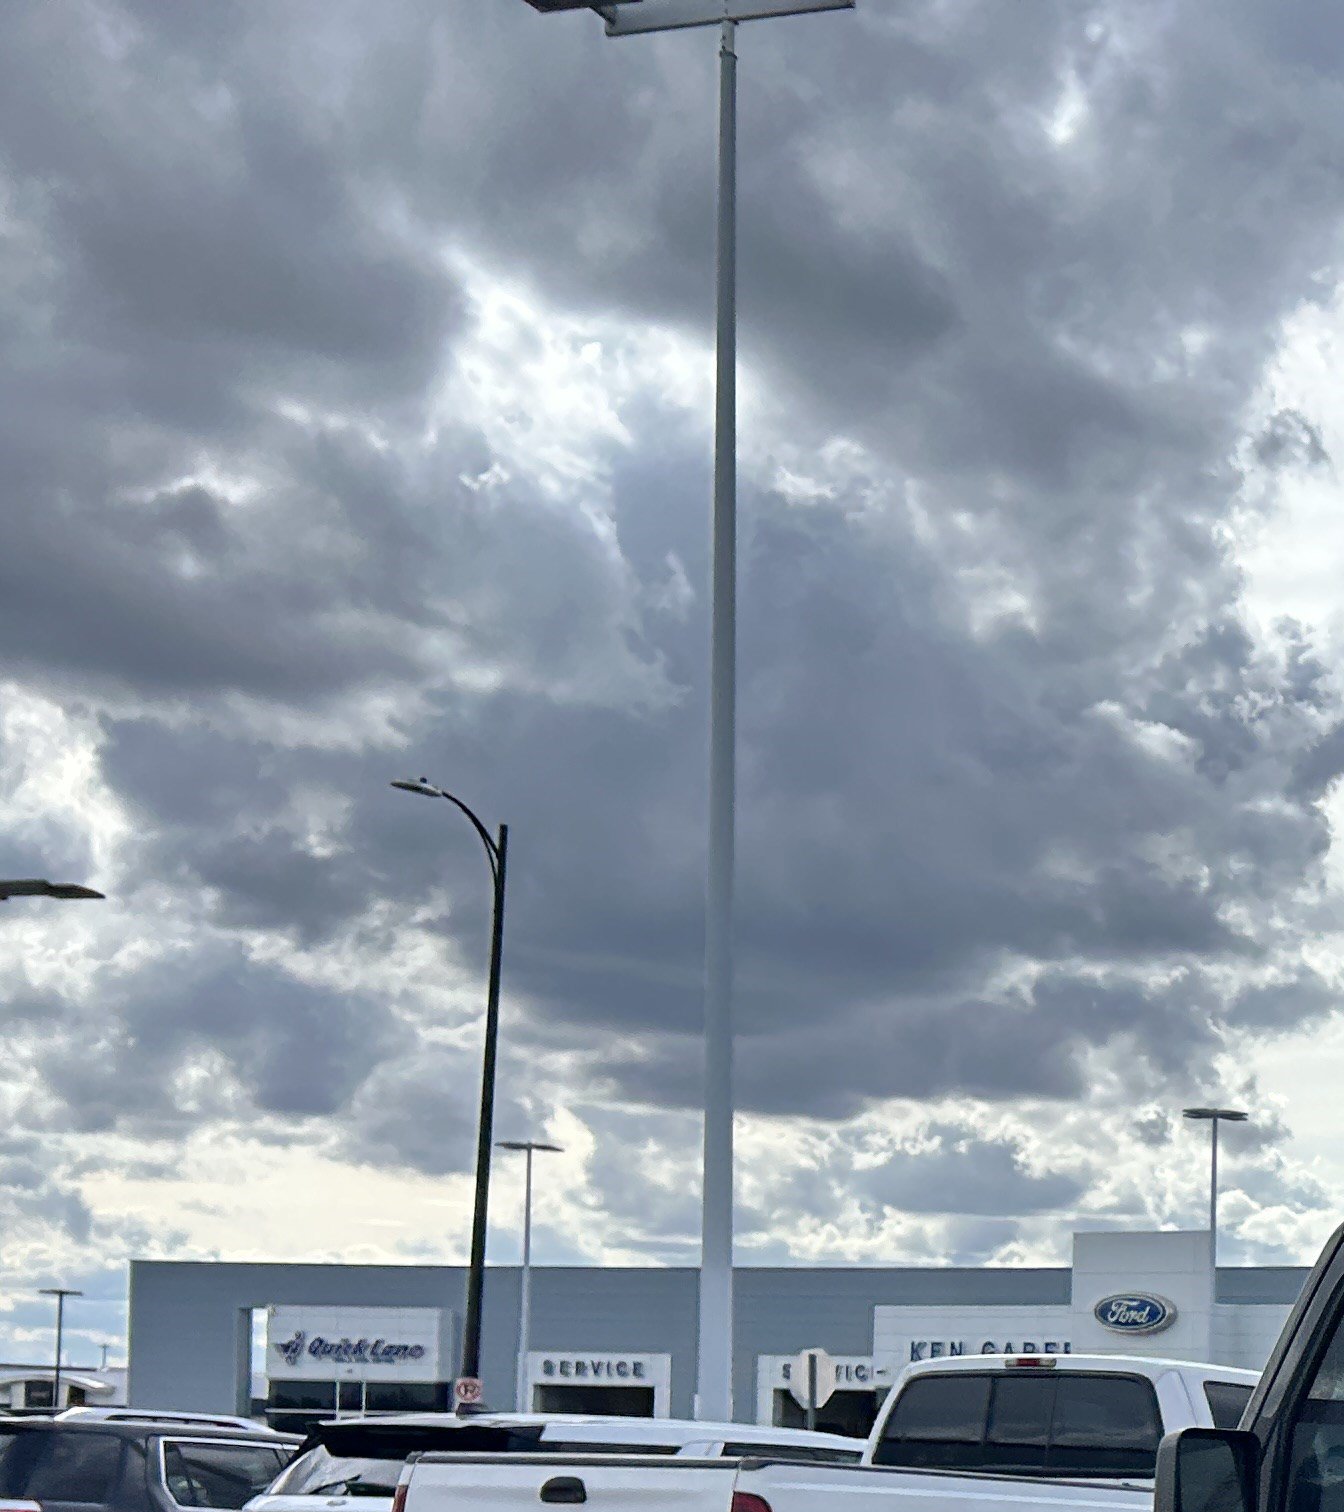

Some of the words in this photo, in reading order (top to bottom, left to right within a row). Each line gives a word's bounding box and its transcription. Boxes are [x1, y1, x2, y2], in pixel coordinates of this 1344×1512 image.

[1107, 1300, 1151, 1323] Ford
[911, 1341, 963, 1361] KEN
[543, 1359, 645, 1378] SERVICE
